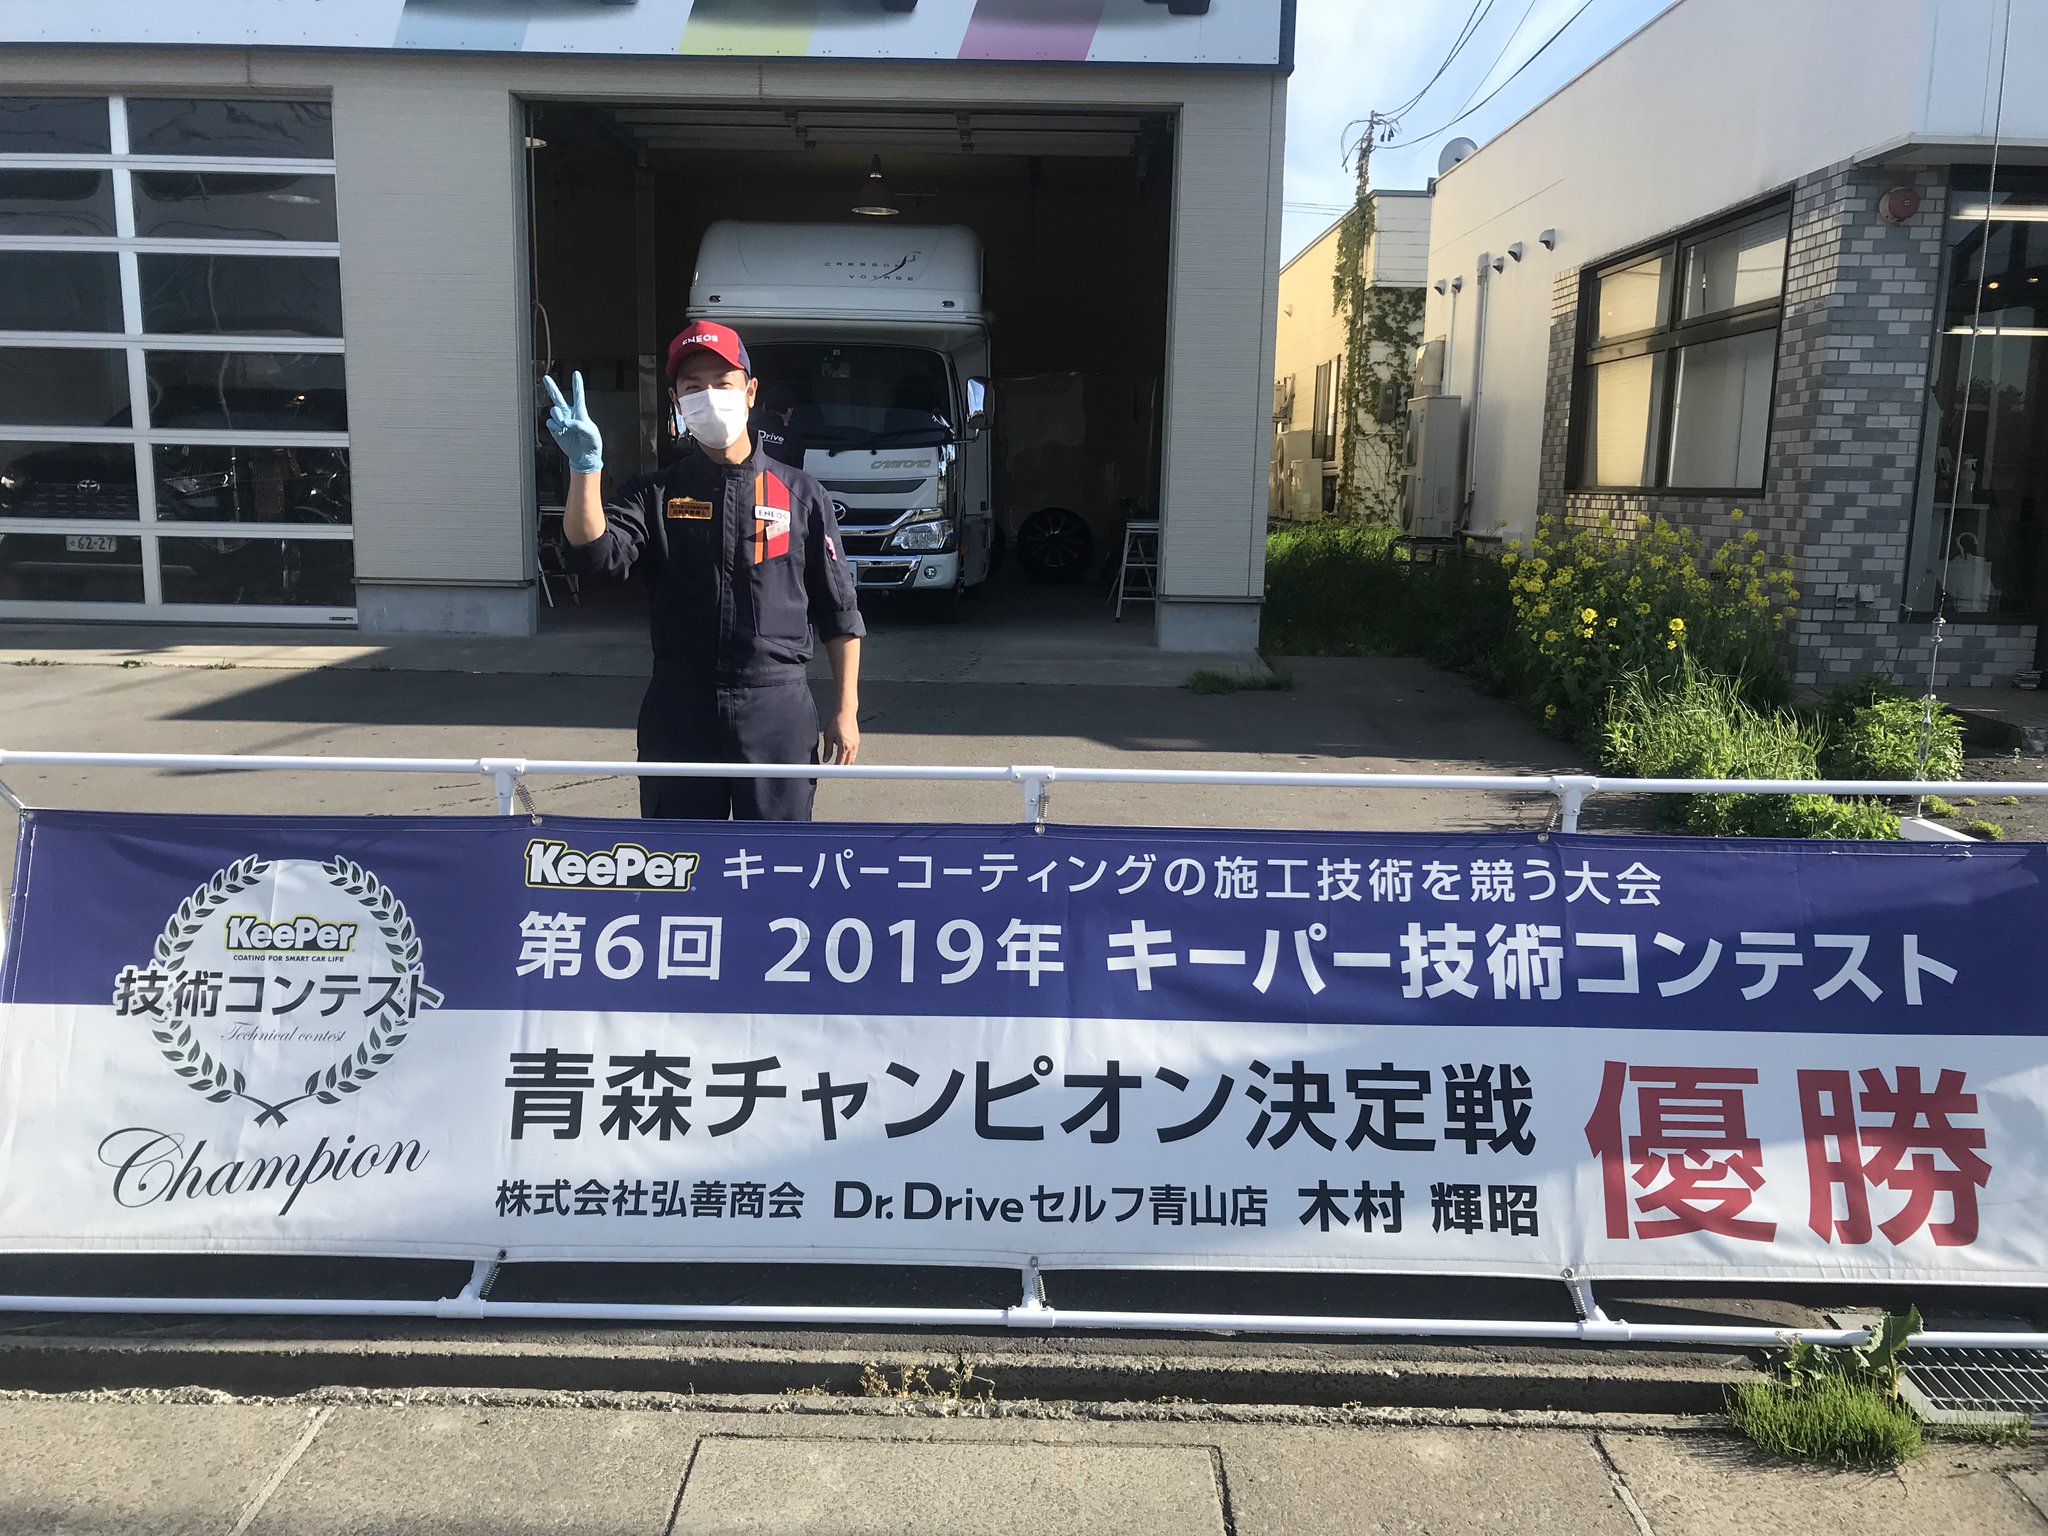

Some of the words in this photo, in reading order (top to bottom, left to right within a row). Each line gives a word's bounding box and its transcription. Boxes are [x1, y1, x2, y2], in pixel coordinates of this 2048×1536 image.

[682, 334, 718, 346] ENEOS
[758, 509, 787, 520] ENEOS
[525, 839, 699, 891] KeePer
[722, 848, 1663, 906] キーパーコーティングの施工技術を競う大会
[226, 915, 358, 951] KeePer
[233, 954, 266, 962] COATING
[285, 955, 310, 963] SMART
[515, 910, 723, 981] 第6回
[763, 916, 1065, 988] 2019年
[1106, 918, 1958, 1006] キーパー技術コンテスト
[115, 969, 441, 1020] 技術コンテスト
[221, 1021, 298, 1042] Technical
[298, 1030, 346, 1042] contest
[504, 1047, 1536, 1156] 青森チャンピオン決定戦
[97, 1126, 431, 1216] Champion
[1584, 1060, 1993, 1247] 優勝
[495, 1178, 806, 1220] 株式会社弘善商会
[1298, 1179, 1405, 1234] 木村
[1429, 1182, 1540, 1238] 輝昭
